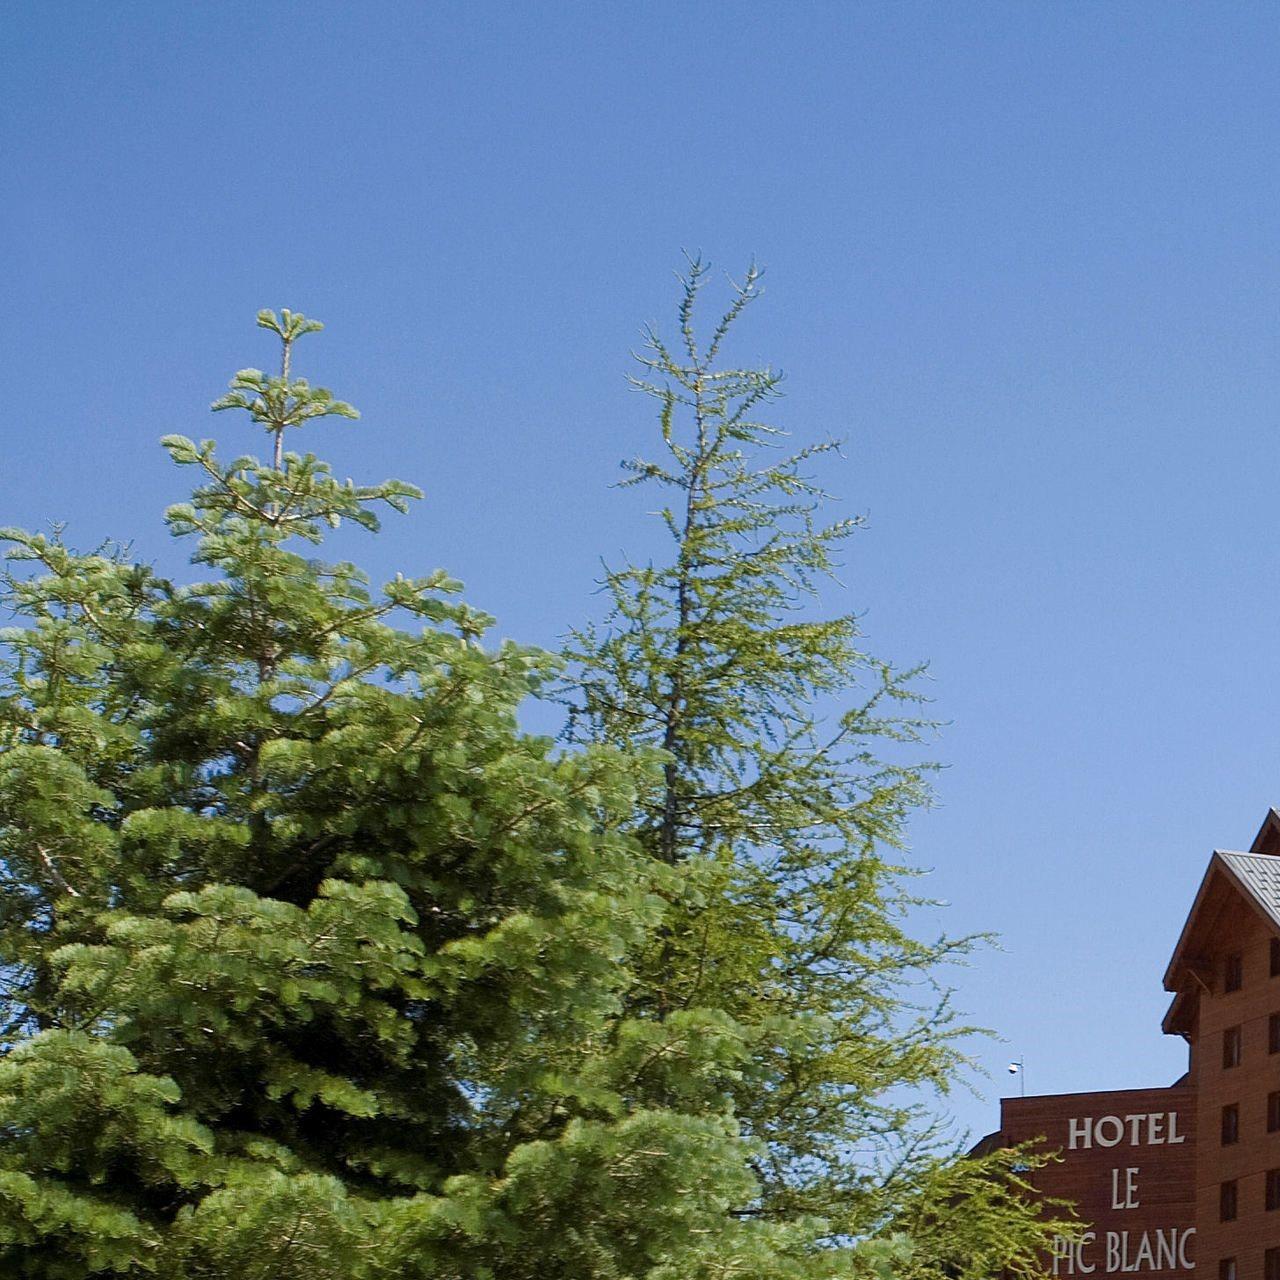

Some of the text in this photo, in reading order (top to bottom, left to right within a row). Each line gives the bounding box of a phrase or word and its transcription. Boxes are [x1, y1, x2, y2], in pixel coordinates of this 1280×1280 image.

[1068, 1112, 1185, 1150] HOTEL
[1111, 1167, 1140, 1210] LE
[1052, 1228, 1197, 1275] PIC BLANC
